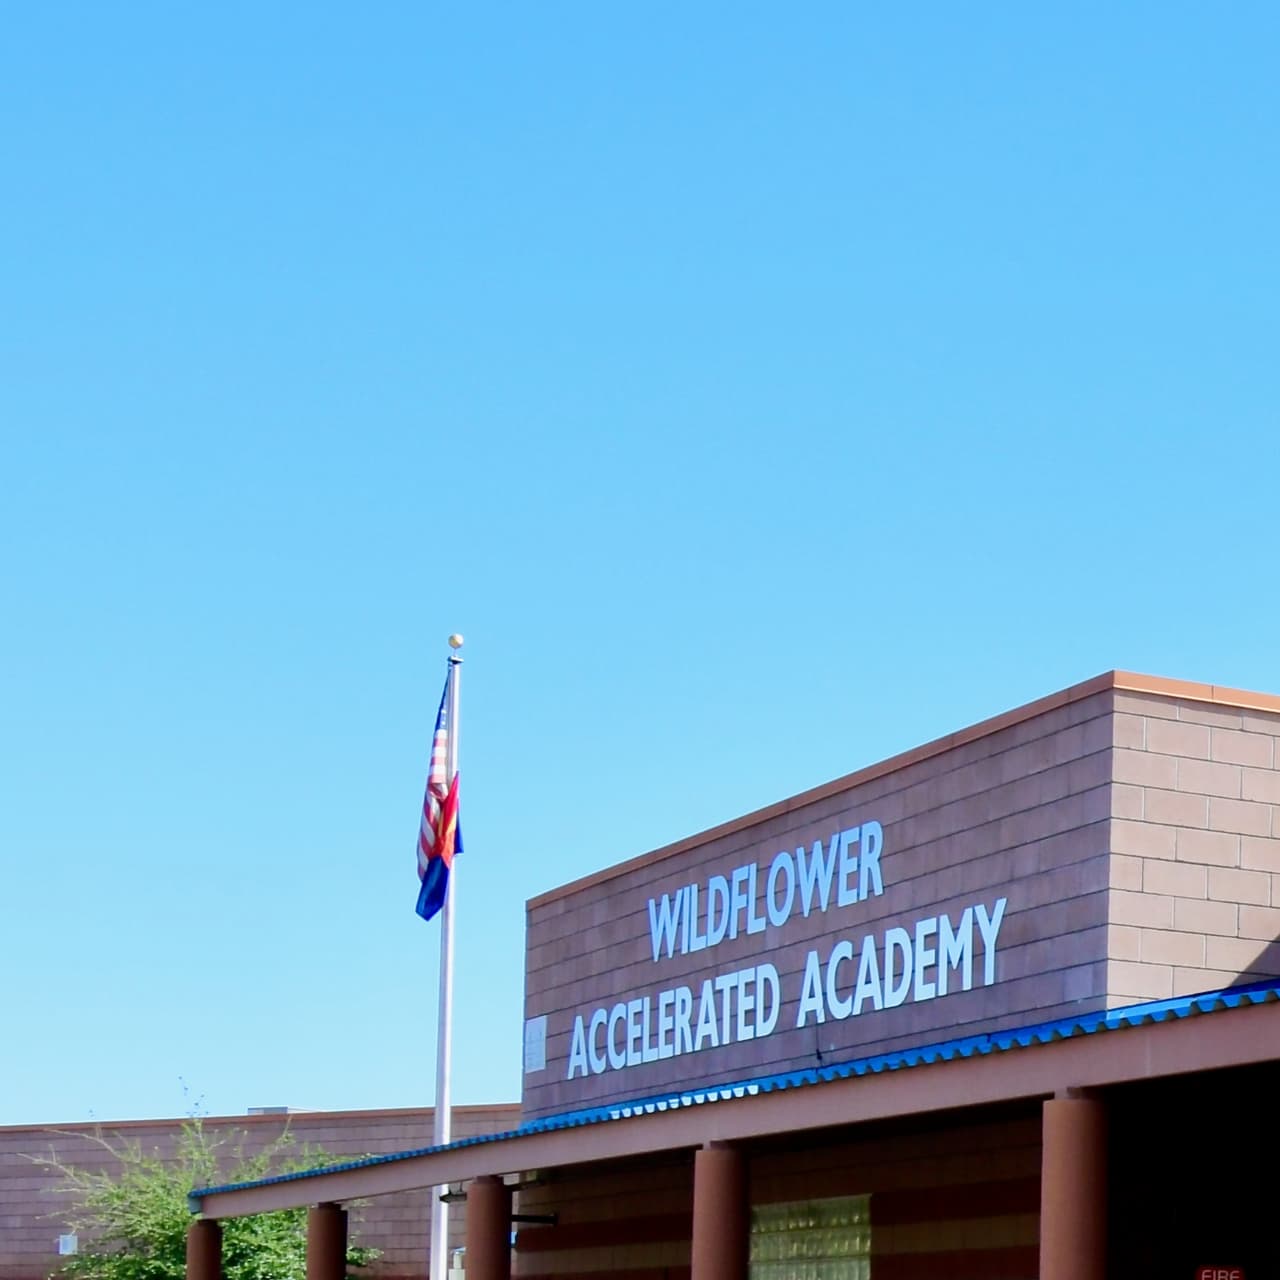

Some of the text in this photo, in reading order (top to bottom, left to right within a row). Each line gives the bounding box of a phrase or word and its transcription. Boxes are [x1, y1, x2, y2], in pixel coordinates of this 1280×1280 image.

[648, 820, 884, 963] WILDFLOWER
[567, 897, 1008, 1080] ACCELERATED ACADEMY
